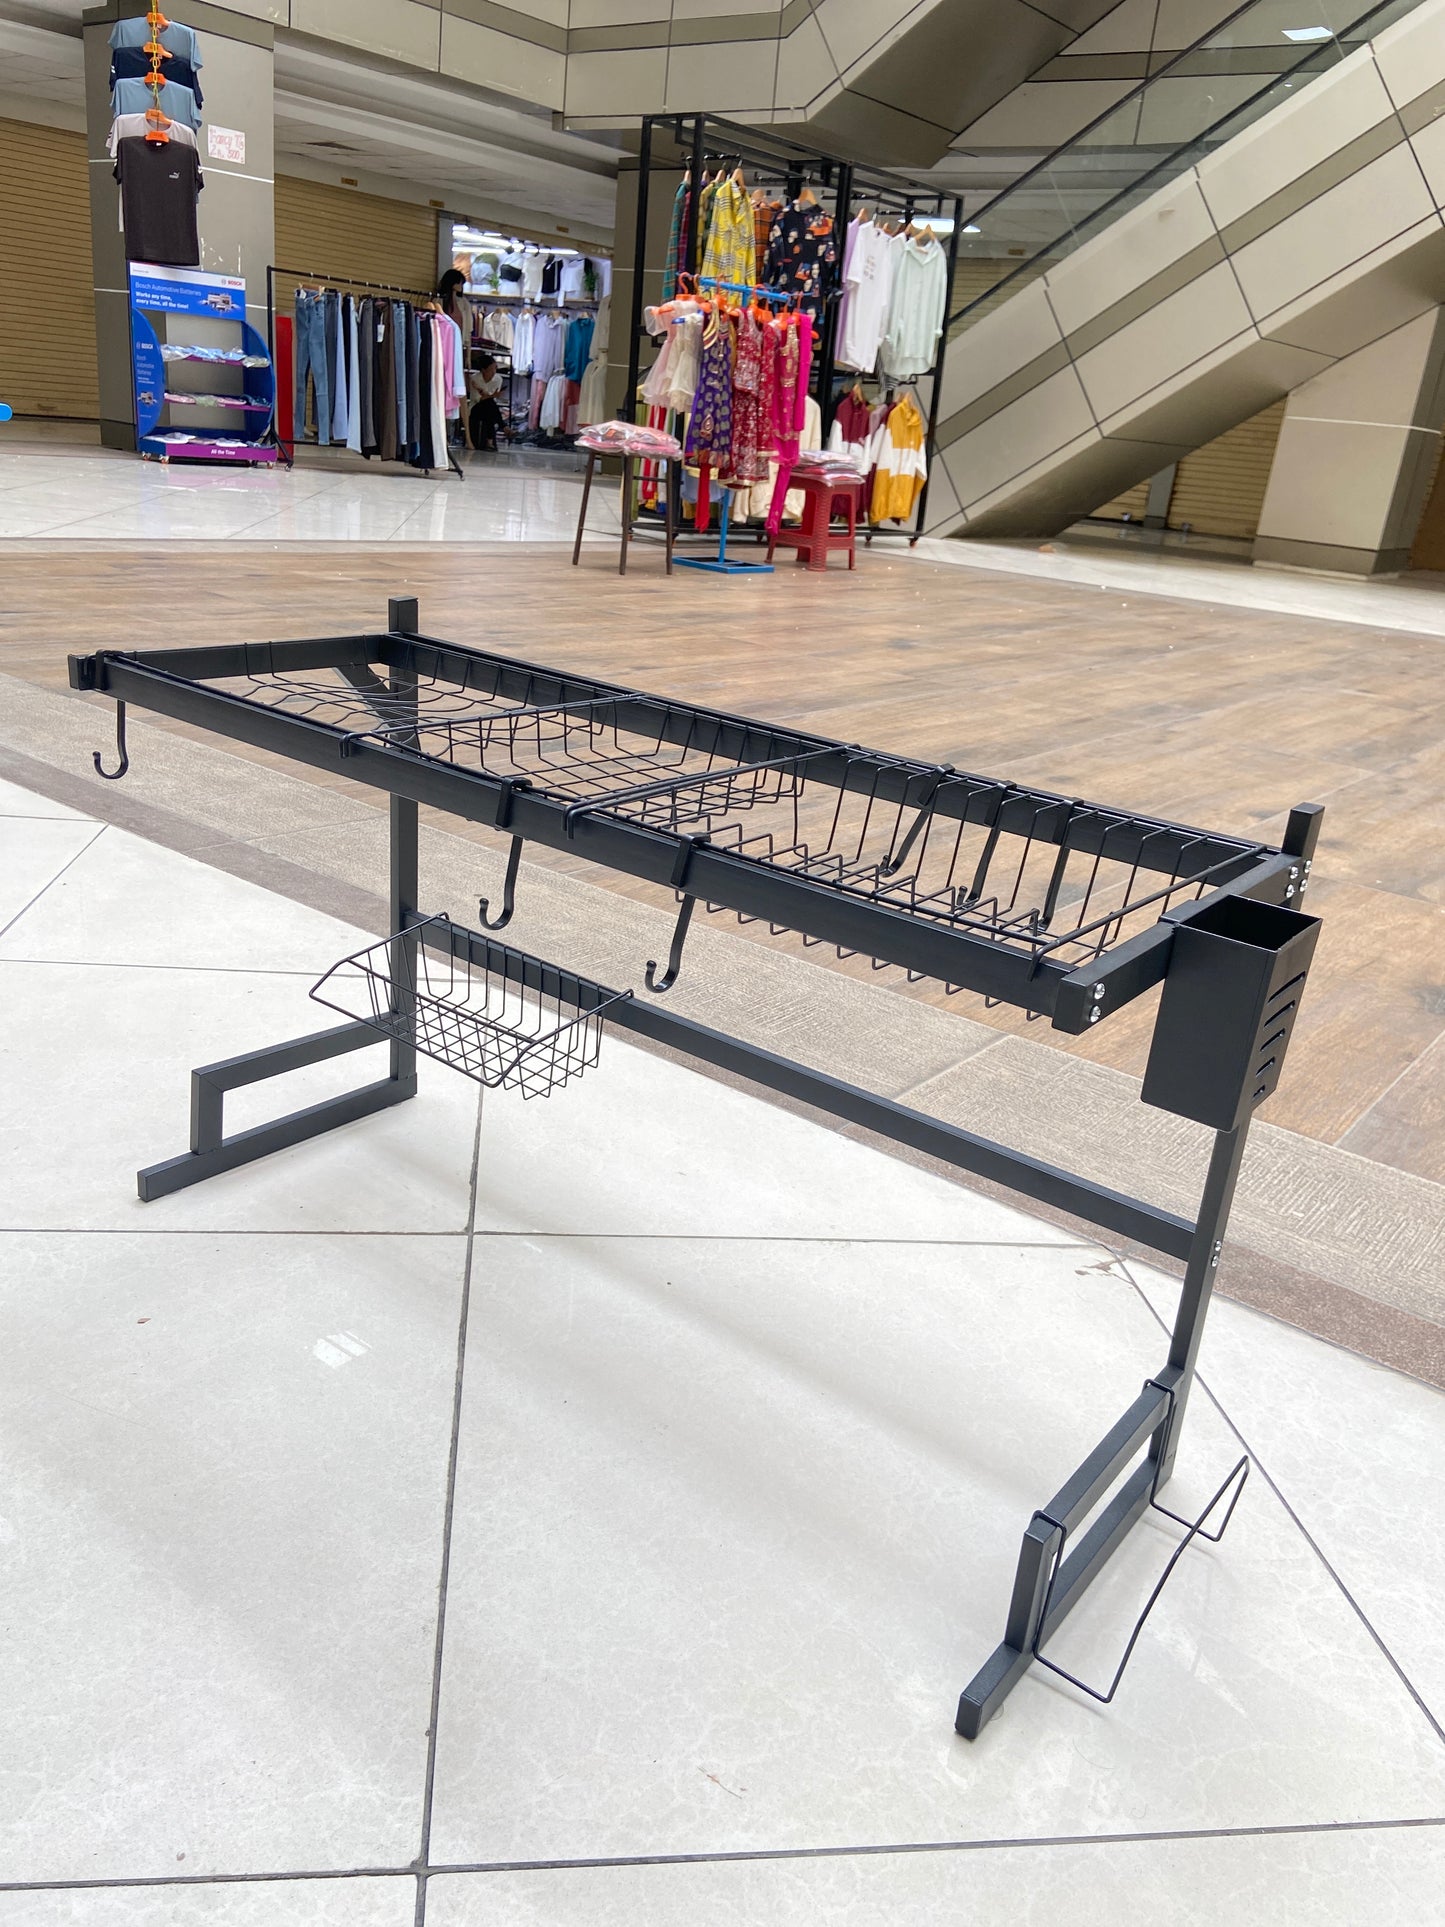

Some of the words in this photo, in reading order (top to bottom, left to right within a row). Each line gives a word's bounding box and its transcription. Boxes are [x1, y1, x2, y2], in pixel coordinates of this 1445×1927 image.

[135, 281, 152, 290] Bosch
[152, 284, 180, 294] Automotive
[180, 287, 201, 297] Batteries
[135, 291, 151, 299] Works
[177, 302, 189, 310] time!
